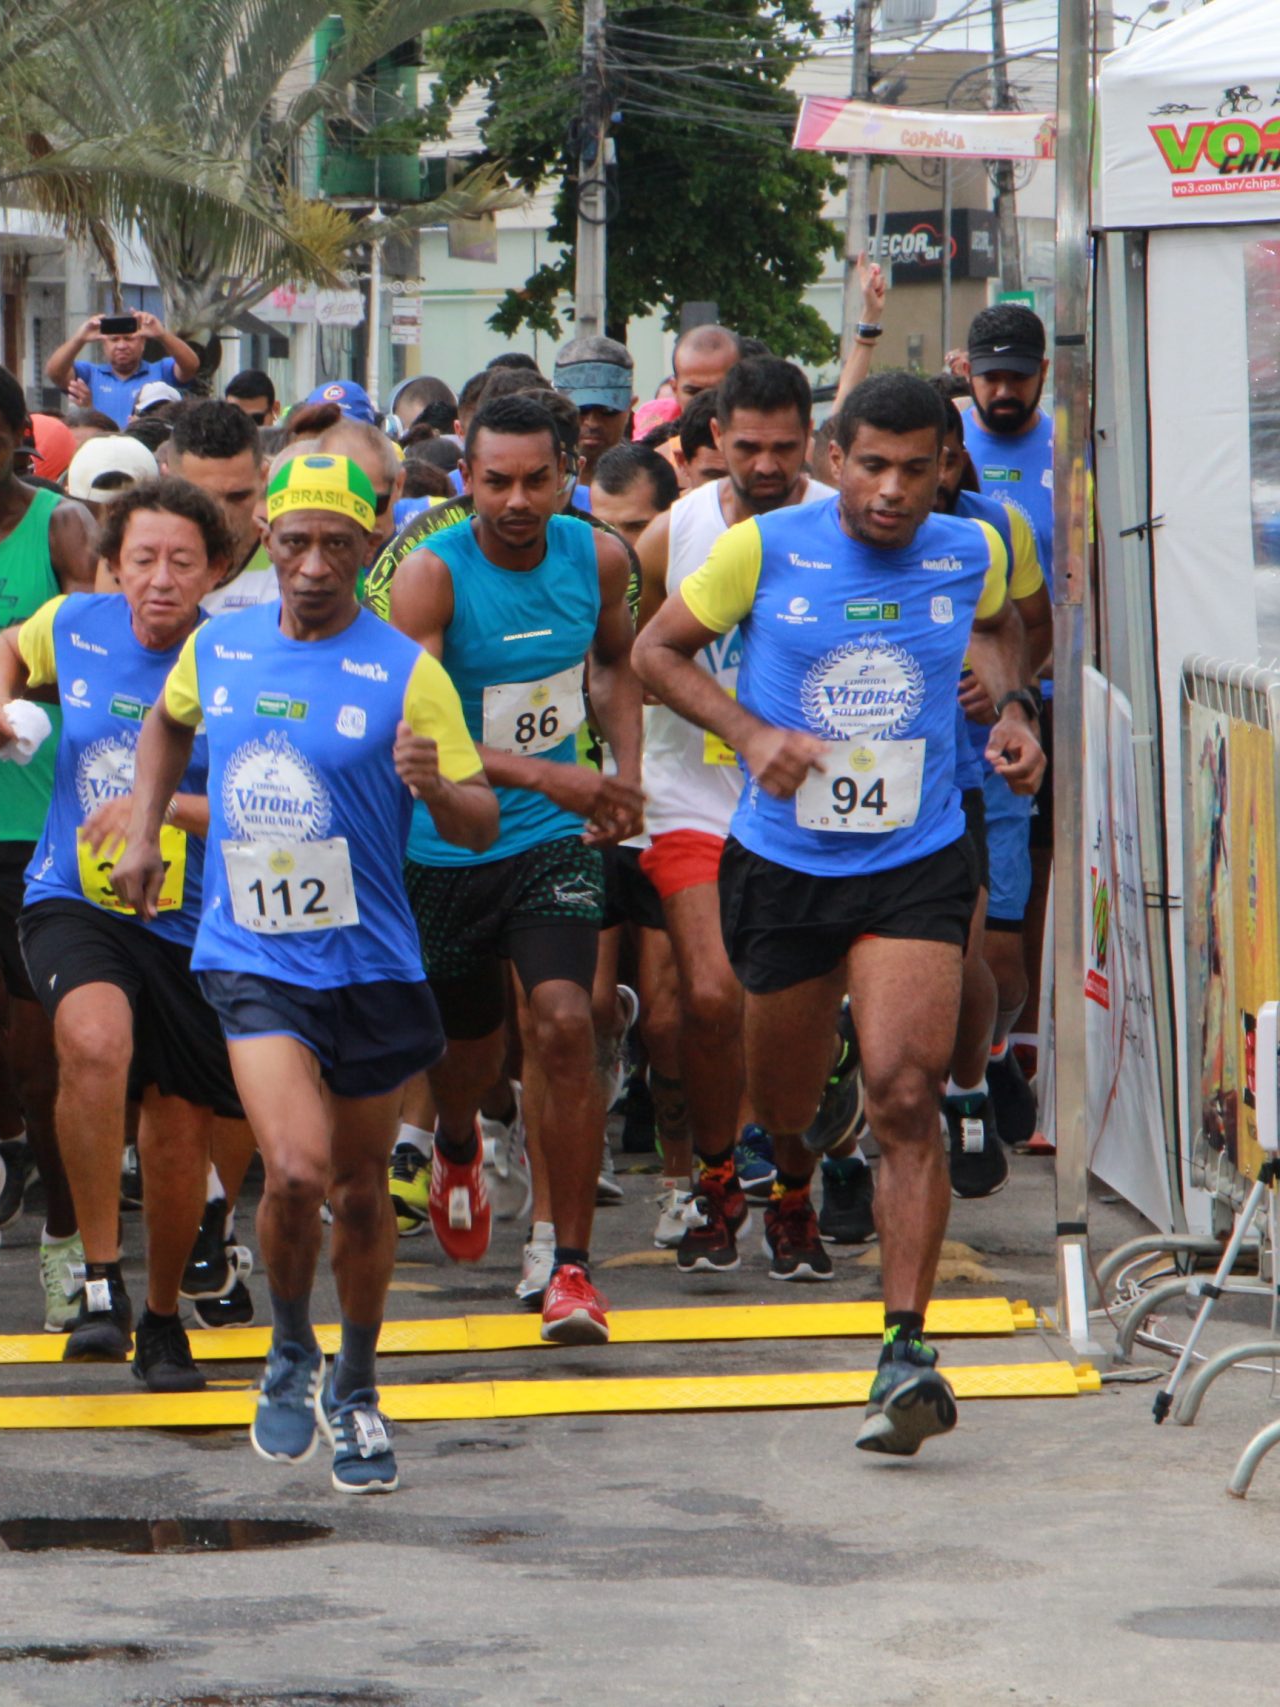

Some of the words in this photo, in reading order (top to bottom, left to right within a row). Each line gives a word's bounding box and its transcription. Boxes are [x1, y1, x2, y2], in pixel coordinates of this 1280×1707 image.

[290, 488, 348, 508] BRASIL
[824, 686, 909, 706] VITÓRIA
[515, 705, 558, 744] 86
[235, 788, 314, 816] VITÓRIA
[832, 777, 888, 815] 94
[249, 877, 329, 917] 112
